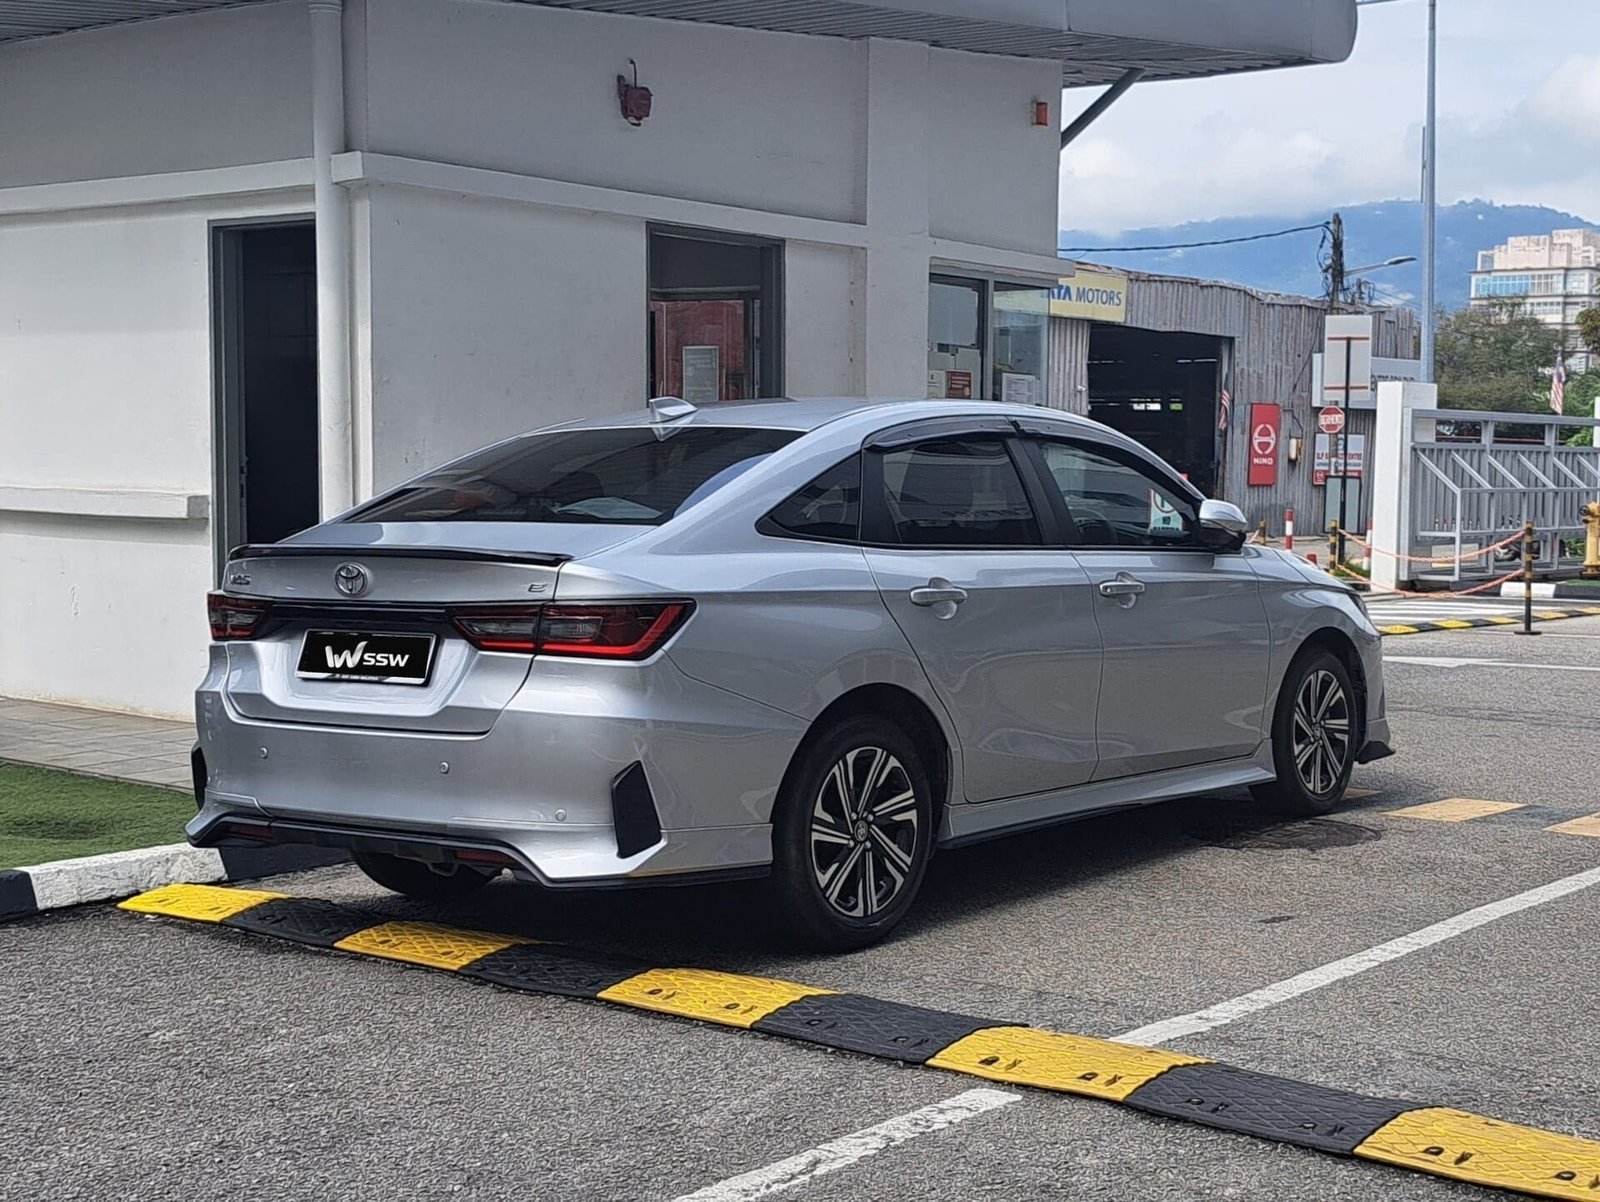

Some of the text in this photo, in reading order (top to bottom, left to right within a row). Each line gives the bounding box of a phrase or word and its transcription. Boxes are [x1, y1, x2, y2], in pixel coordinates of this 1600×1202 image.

[1075, 286, 1122, 307] MOTORS
[1253, 457, 1274, 465] HINO
[527, 583, 548, 593] E
